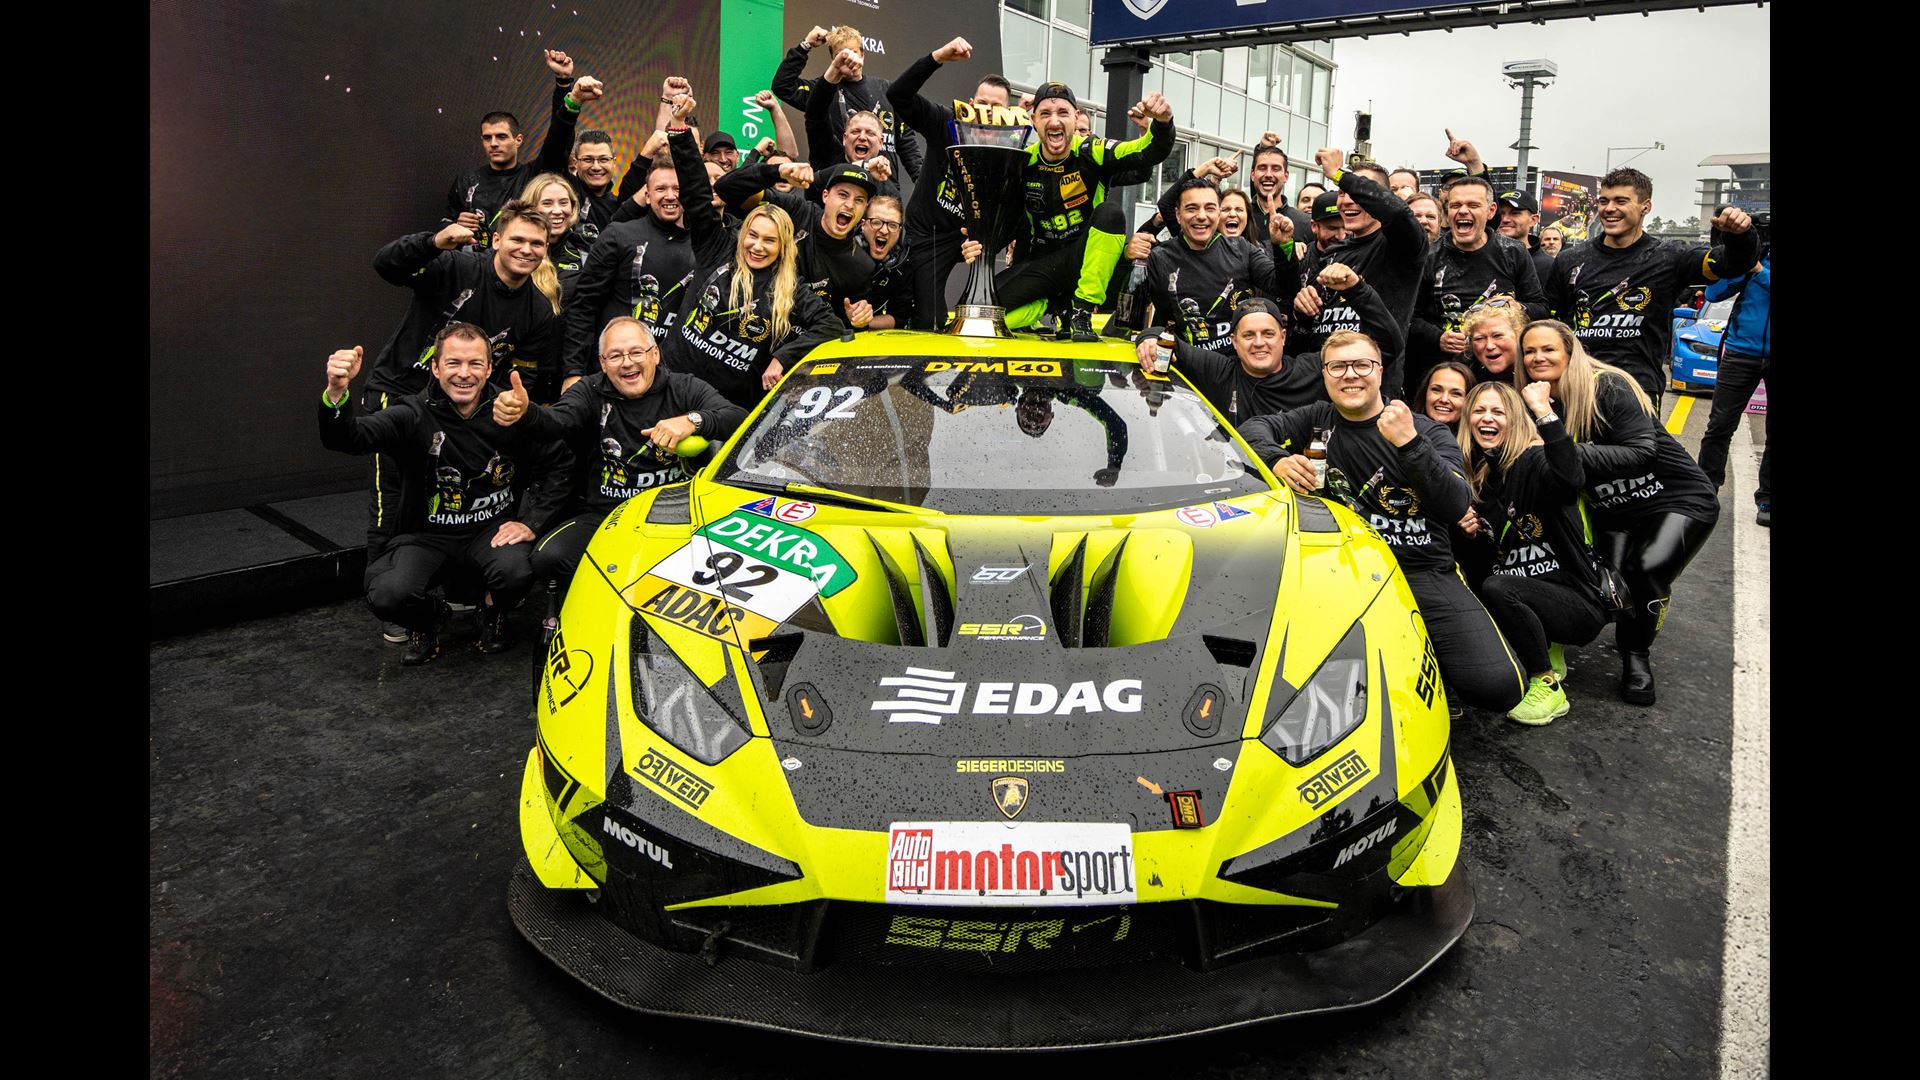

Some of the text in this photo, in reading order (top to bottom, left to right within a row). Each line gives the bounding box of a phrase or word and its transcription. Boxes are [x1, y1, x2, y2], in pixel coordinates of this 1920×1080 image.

[742, 95, 764, 139] We
[953, 99, 1033, 127] DTM
[953, 149, 981, 219] CHAMPION
[1060, 172, 1081, 186] ADAC
[1322, 306, 1361, 323] DTM
[1592, 314, 1645, 327] DTM
[708, 329, 759, 362] DTM
[1574, 328, 1613, 338] AMPION
[681, 324, 725, 361] CHAMPION
[724, 354, 751, 373] 2024
[924, 361, 1055, 374] DTM 40
[794, 386, 865, 419] 92
[600, 484, 641, 498] CHAMP
[1631, 481, 1665, 499] 2024
[428, 508, 493, 525] CHAMPION
[1370, 513, 1427, 534] DTM
[708, 515, 838, 593] DEKRA
[1528, 559, 1560, 577] 2024
[691, 551, 779, 603] 92
[640, 584, 745, 636] ADAC
[957, 623, 1024, 636] SSR
[550, 628, 572, 680] SR
[971, 678, 1143, 716] EDAG
[1181, 796, 1196, 824] OMP
[602, 815, 674, 870] MOTUL
[890, 831, 932, 861] Auto
[1332, 816, 1398, 870] MOTUL
[892, 859, 930, 888] Bild
[884, 914, 1067, 953] SSR
